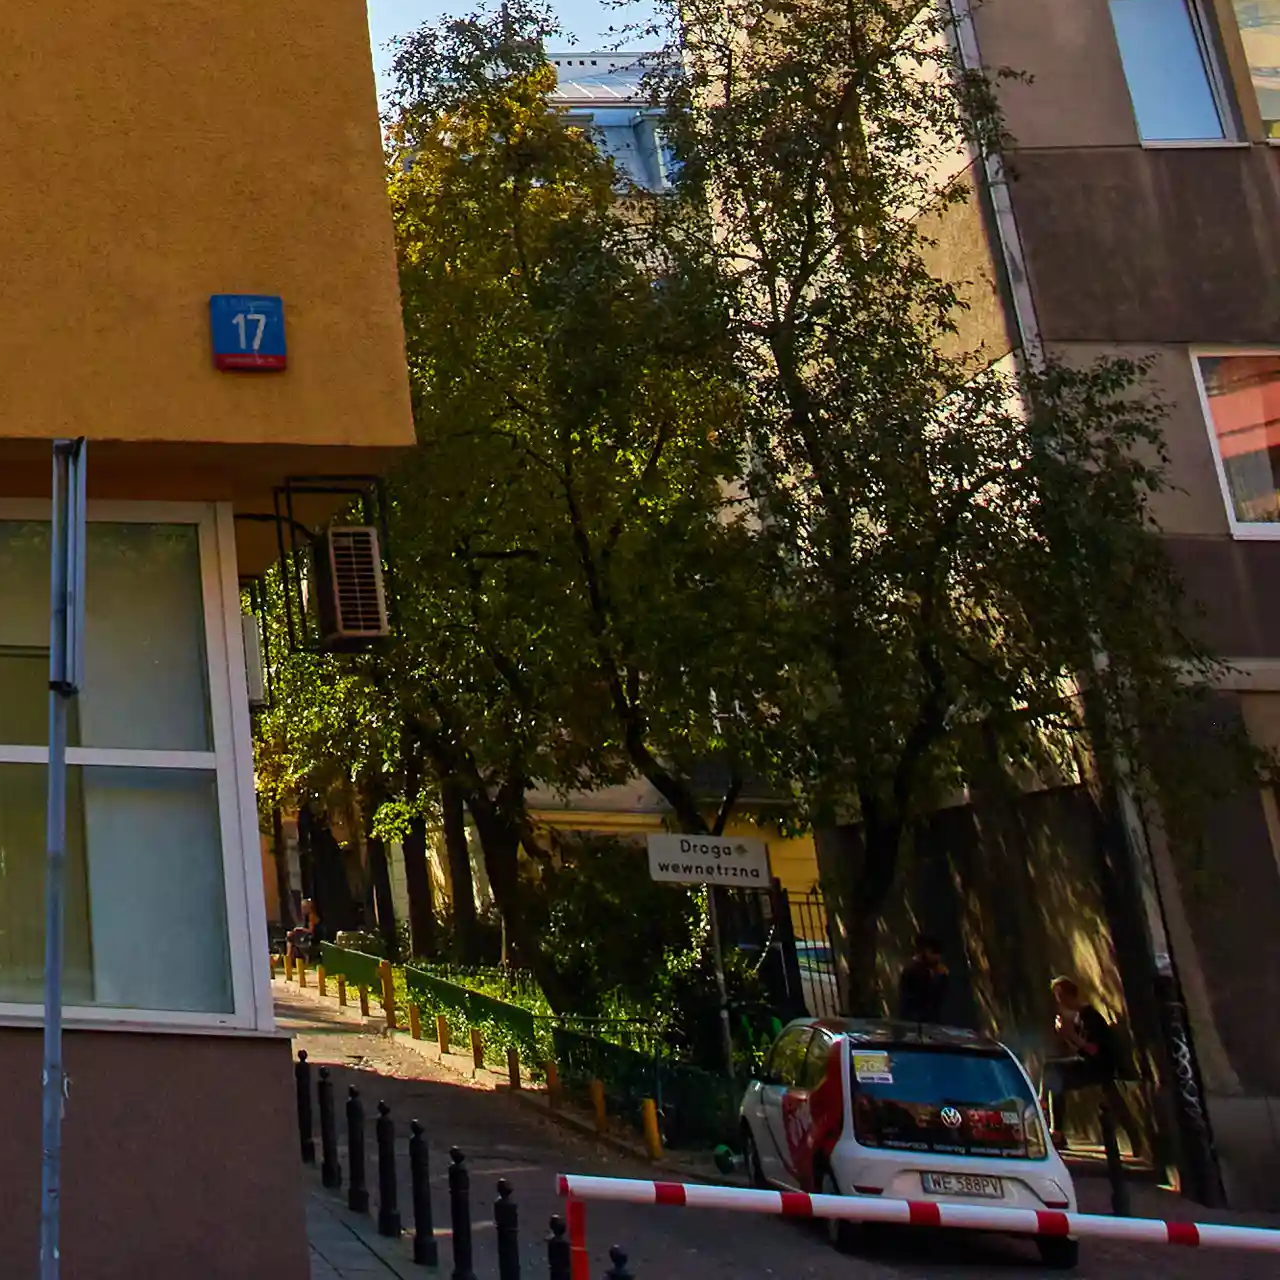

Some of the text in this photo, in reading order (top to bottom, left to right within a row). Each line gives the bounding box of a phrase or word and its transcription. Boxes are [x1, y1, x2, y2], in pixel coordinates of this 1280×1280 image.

[231, 313, 267, 351] 17
[680, 838, 733, 859] Droga
[658, 860, 760, 879] wewnętrzna
[930, 1173, 953, 1190] WE
